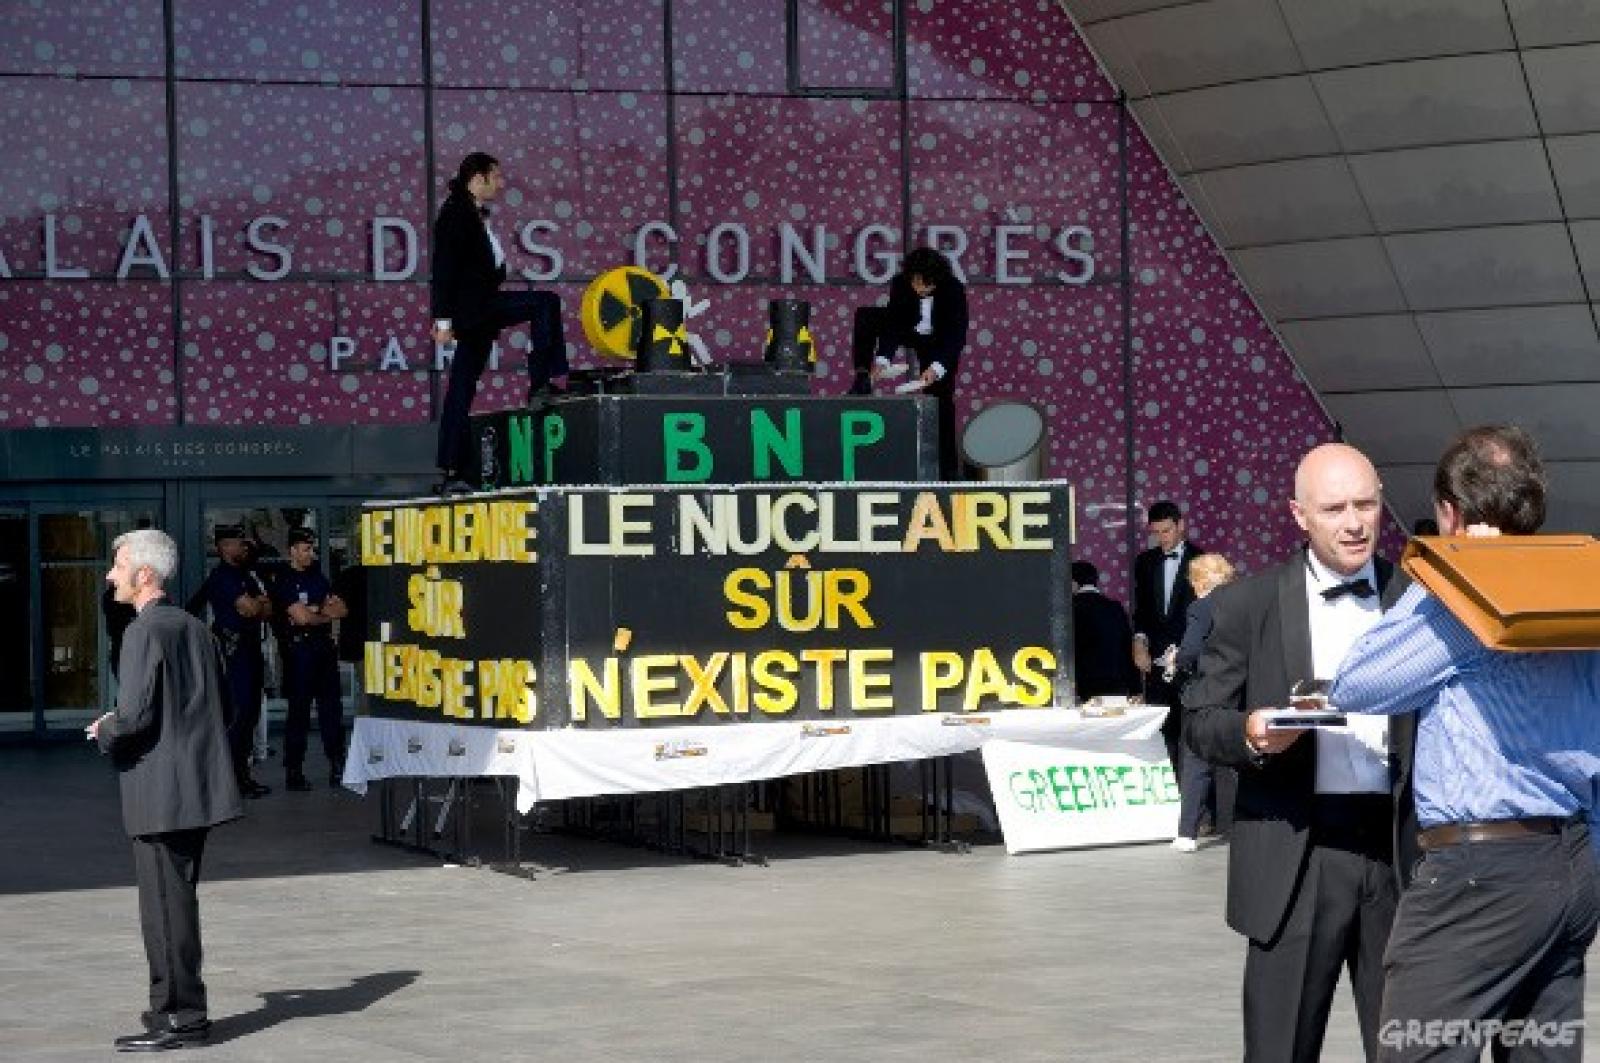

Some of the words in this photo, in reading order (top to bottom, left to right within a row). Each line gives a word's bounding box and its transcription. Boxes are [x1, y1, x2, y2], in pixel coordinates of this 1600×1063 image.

[0, 214, 292, 280] LAIS
[373, 217, 564, 281] DS
[634, 205, 1095, 284] CONGRÈS
[331, 337, 533, 370] PARI
[664, 408, 885, 481] BNP
[362, 509, 392, 566] LE
[568, 494, 655, 555] LE
[679, 491, 1053, 555] NUCLEAIRE
[723, 554, 876, 632] SÛR
[478, 657, 537, 723] PAS
[569, 627, 893, 721] N'EXISTE
[920, 646, 1057, 712] PAS
[1009, 765, 1181, 813] GREENPEACE
